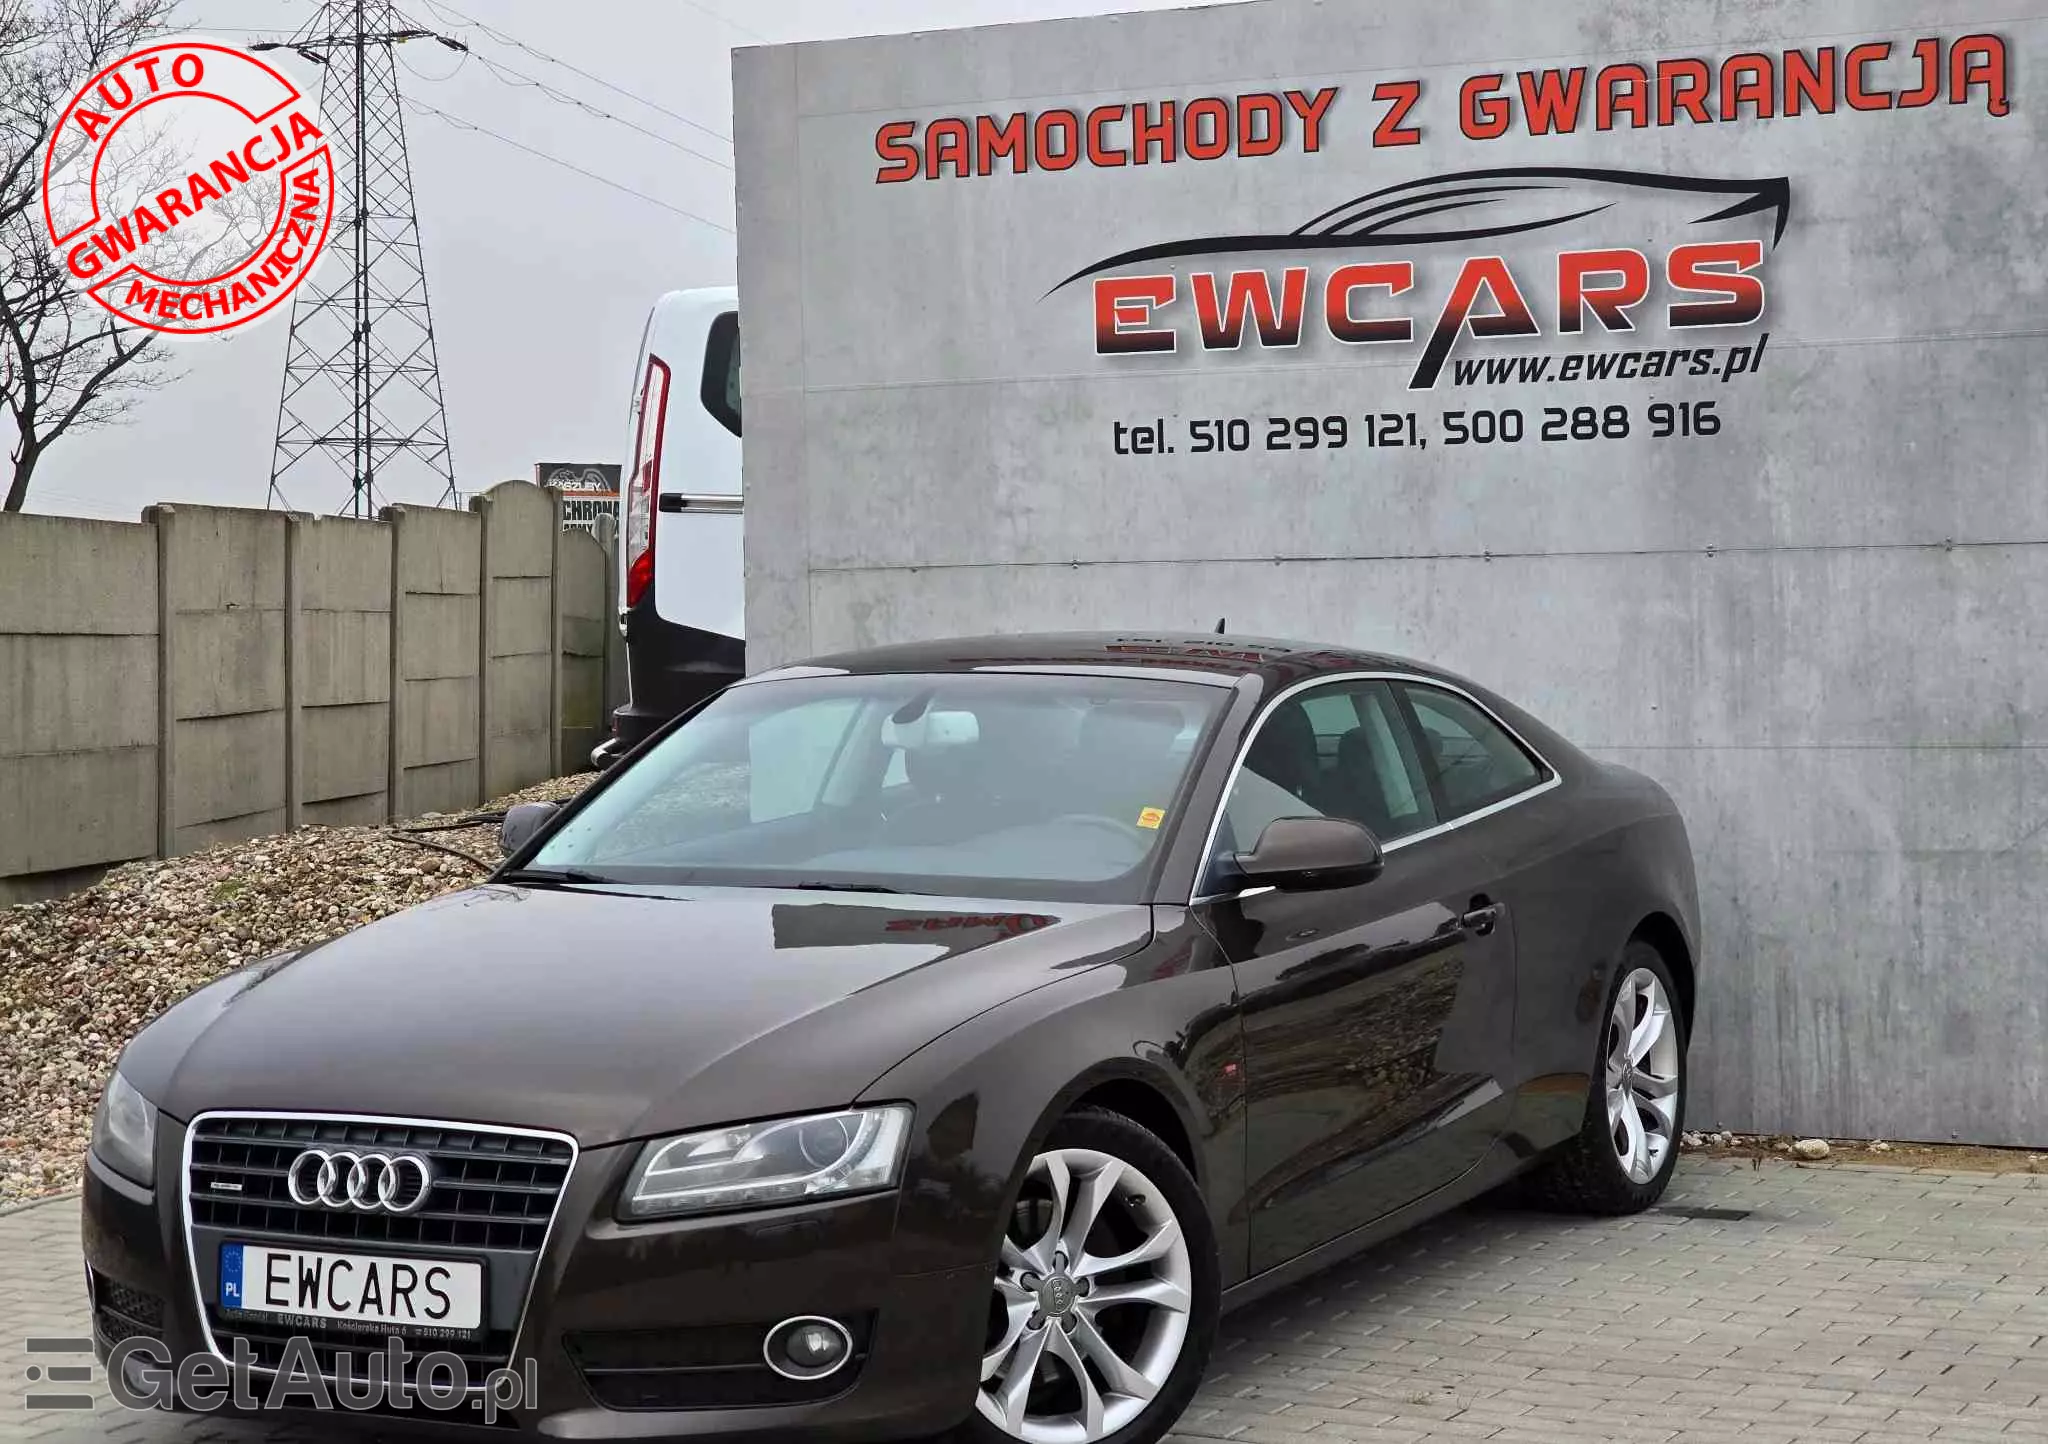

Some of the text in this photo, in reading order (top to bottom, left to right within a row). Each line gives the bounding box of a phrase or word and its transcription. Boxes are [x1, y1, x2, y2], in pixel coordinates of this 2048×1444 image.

[876, 33, 2010, 184] SAMOCHODY Z GWARANCJĄ
[1093, 240, 1765, 391] EWCARS
[1453, 333, 1769, 386] www.ewcars.pl
[1113, 401, 1721, 456] tel. 510 299 121, 500 288 916
[225, 1281, 241, 1298] PL
[265, 1252, 451, 1320] EWCARS
[277, 1312, 327, 1330] EWCARS
